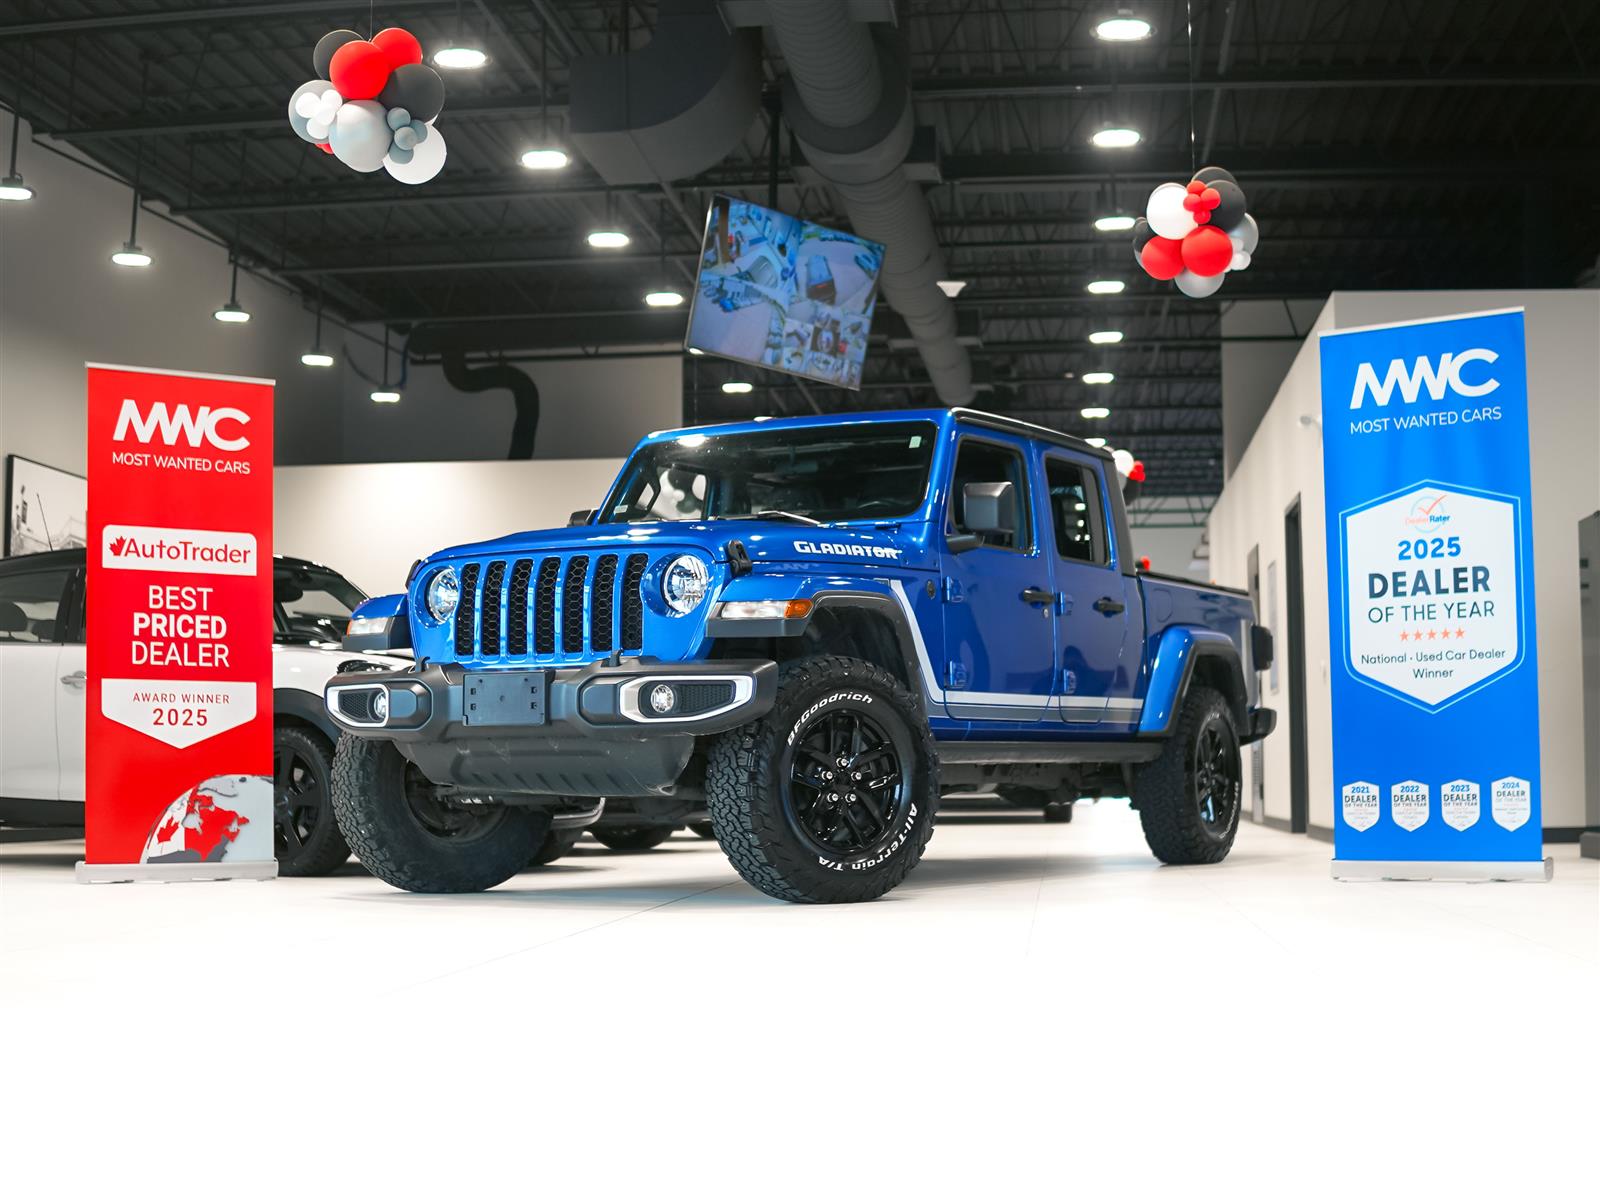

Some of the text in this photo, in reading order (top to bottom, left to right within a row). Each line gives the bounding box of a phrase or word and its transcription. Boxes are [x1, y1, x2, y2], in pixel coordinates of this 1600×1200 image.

[1350, 348, 1500, 410] MWC
[113, 399, 251, 451] MWC
[1350, 406, 1502, 435] MOST WANTED CARS
[112, 452, 251, 475] MOST WANTED CARS
[124, 537, 251, 564] AutoTrader
[793, 541, 899, 559] GLADIATOR
[1398, 536, 1461, 561] 2025
[1368, 565, 1490, 599] DEALER
[148, 585, 213, 611] BEST
[1368, 600, 1495, 624] OF THE YEAR
[133, 612, 227, 639] PRICED
[131, 641, 230, 668] DEALER
[1361, 648, 1505, 665] National Used Car Dealer
[1412, 668, 1454, 679] Winner
[132, 692, 230, 704] AWARD WINNER
[152, 708, 208, 726] 2025
[787, 691, 873, 746] BFGoodrich
[1393, 794, 1426, 802] DEALER
[1400, 785, 1420, 793] 2022
[1450, 784, 1470, 792] 2023
[818, 856, 844, 871] T/A
